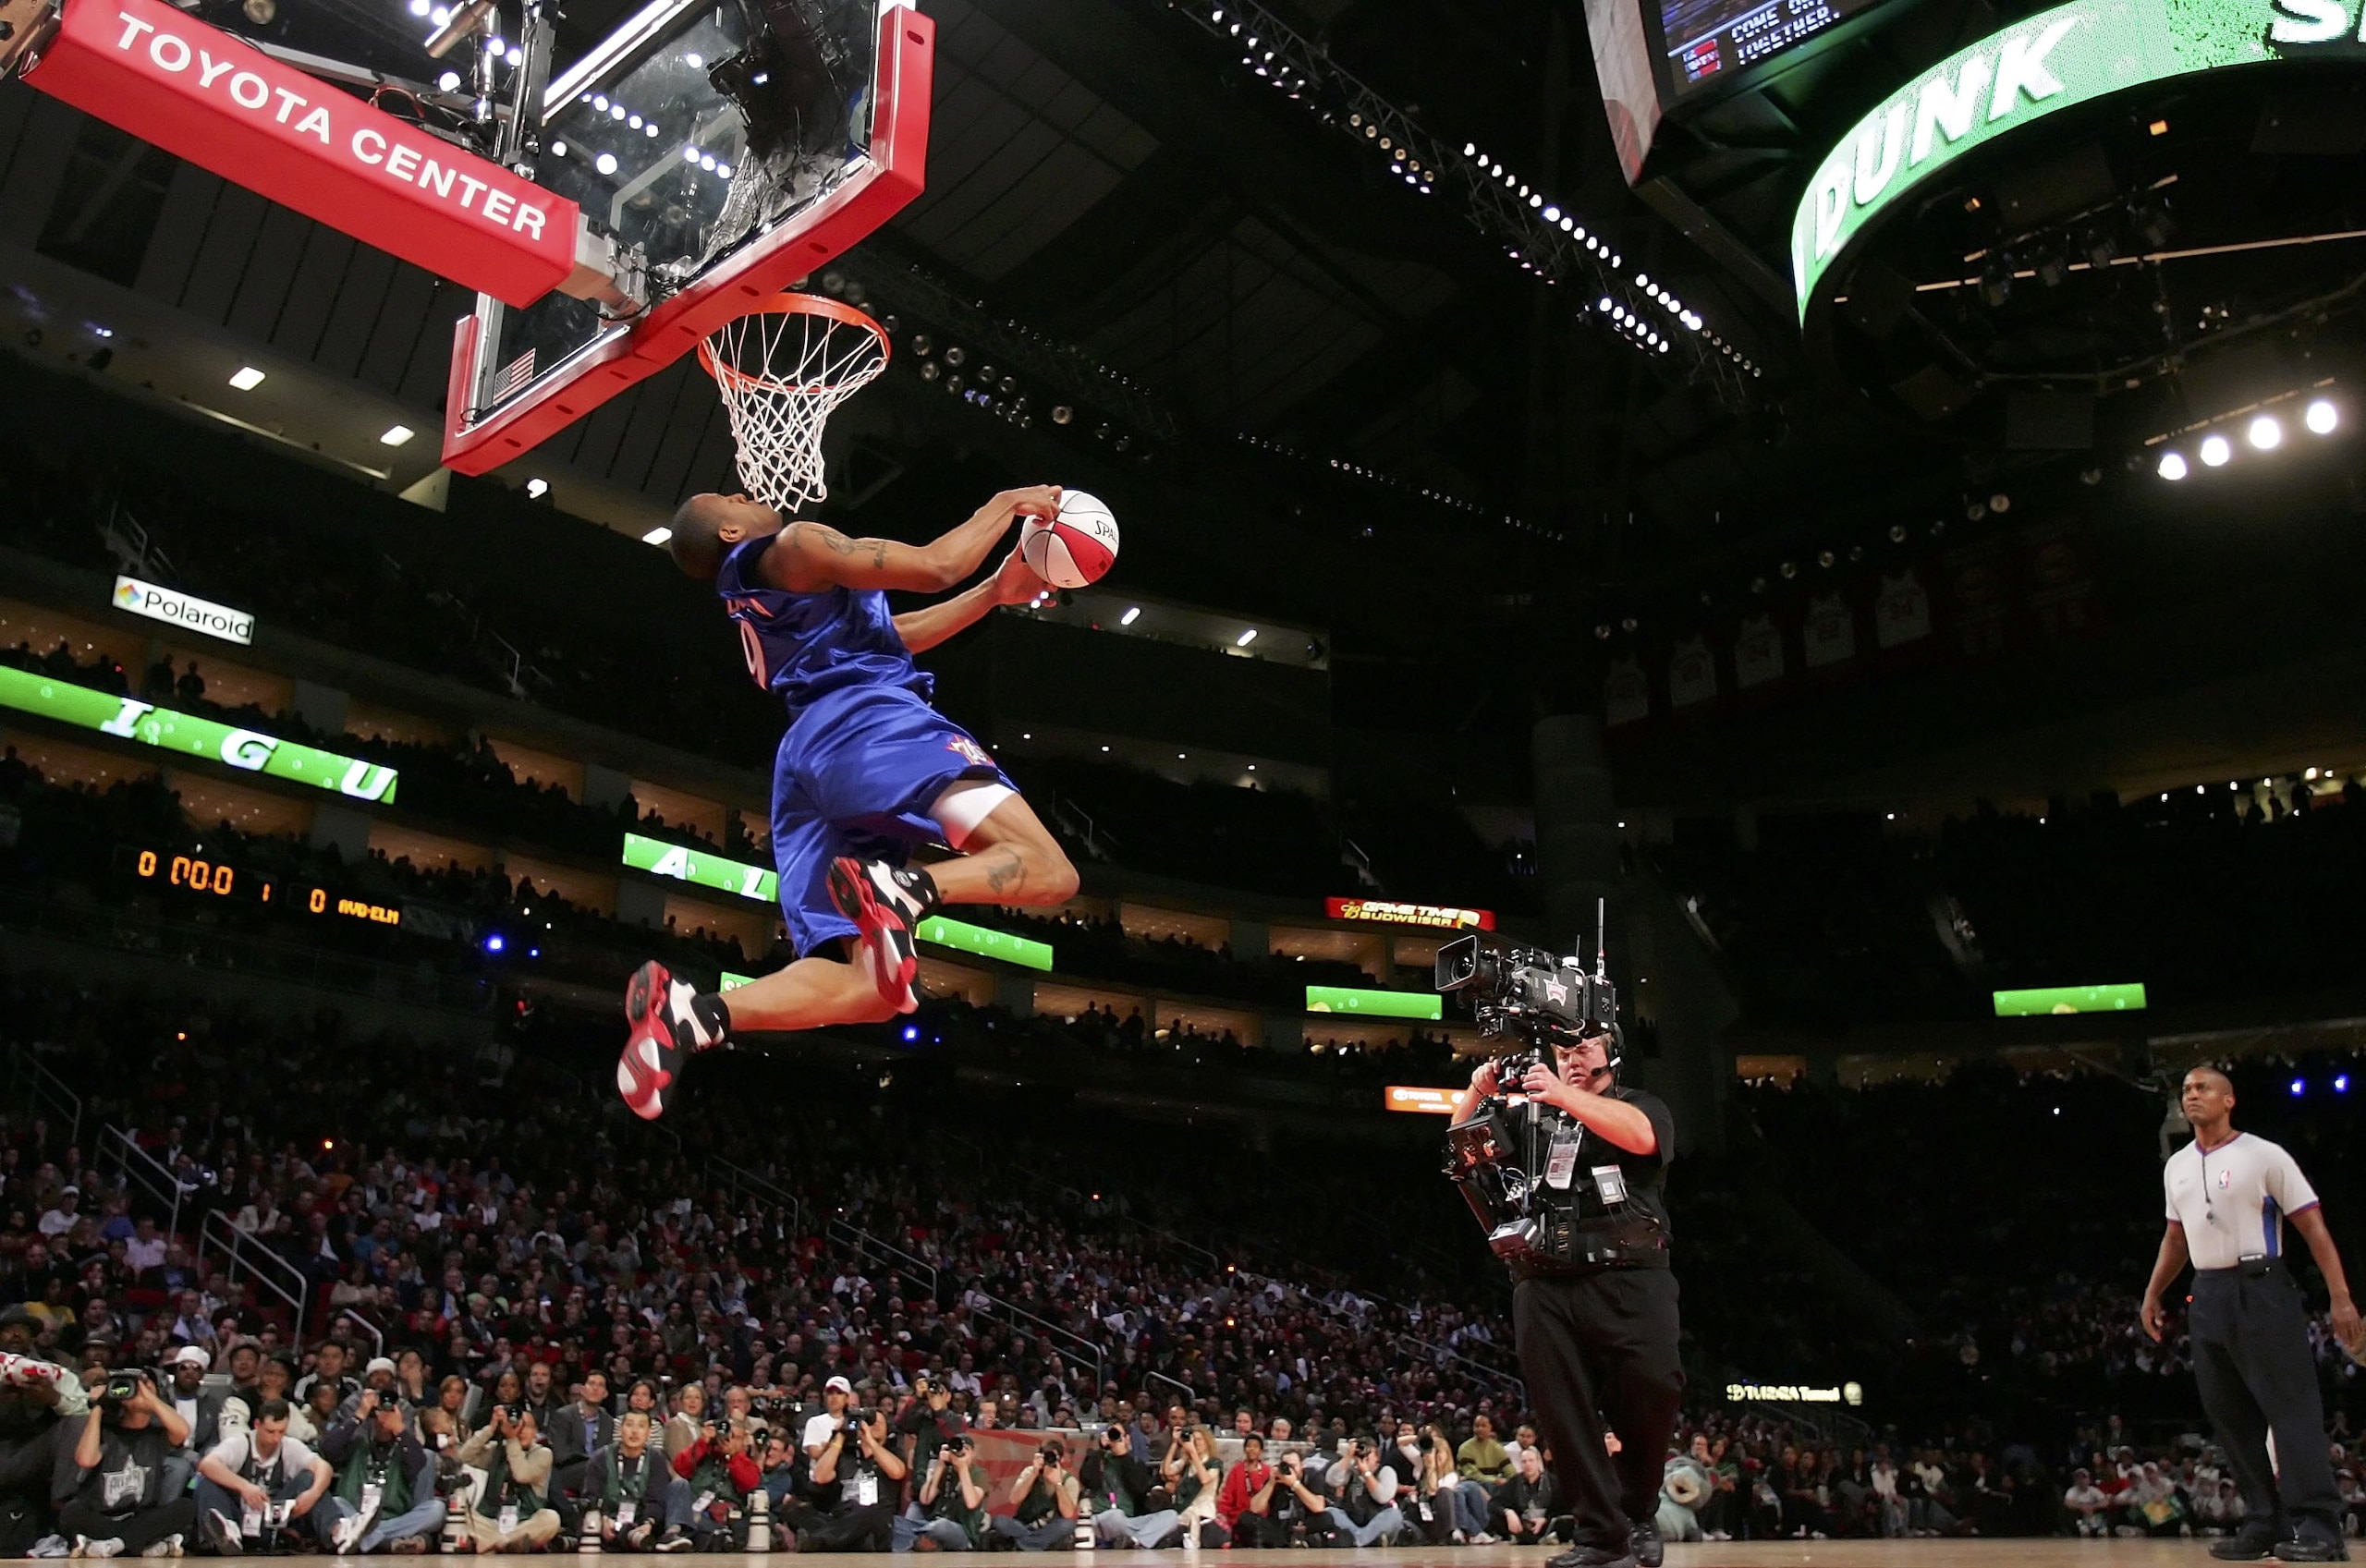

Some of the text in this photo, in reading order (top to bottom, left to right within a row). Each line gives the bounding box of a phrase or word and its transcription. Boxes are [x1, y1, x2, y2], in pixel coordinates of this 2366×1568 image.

[118, 11, 547, 241] TOYOTA CENTER
[1814, 15, 2079, 263] DUNK
[145, 590, 253, 638] Polaroid
[1360, 911, 1453, 927] BUDWEISER
[1361, 901, 1459, 919] GAME TIME
